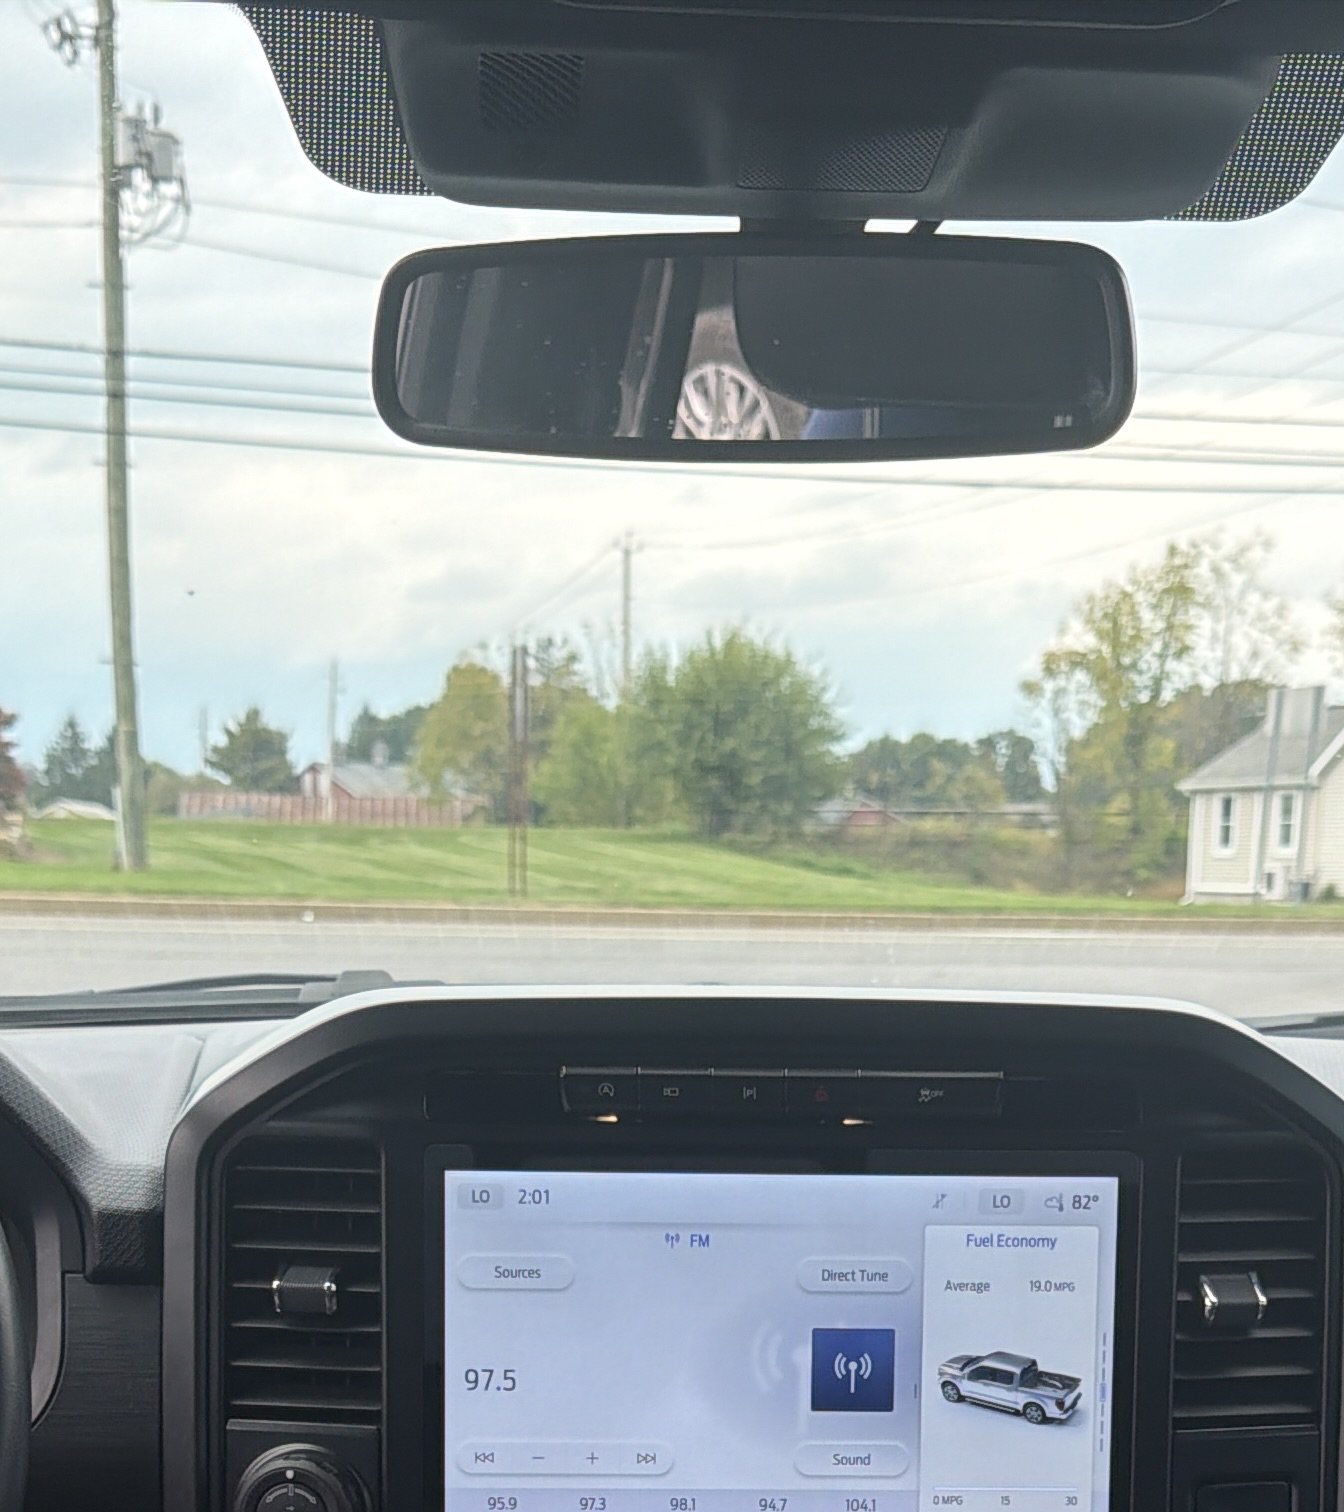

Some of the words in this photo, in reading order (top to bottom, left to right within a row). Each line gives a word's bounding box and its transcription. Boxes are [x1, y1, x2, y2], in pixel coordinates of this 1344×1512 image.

[471, 1189, 490, 1204] LO
[517, 1189, 550, 1205] 2:01
[992, 1195, 1011, 1209] LO
[690, 1233, 710, 1248] FM
[966, 1233, 994, 1248] Fuel
[997, 1234, 1057, 1250] Economy
[494, 1264, 541, 1280] Sources
[821, 1268, 856, 1283] Direct
[859, 1268, 889, 1283] Tune
[944, 1279, 991, 1294] Average
[1029, 1280, 1052, 1293] 19.0
[1053, 1282, 1076, 1293] MPG
[464, 1368, 517, 1393] 97.5
[832, 1452, 871, 1467] Sound
[487, 1497, 518, 1511] 95.9
[579, 1497, 606, 1511] 97.3
[669, 1497, 697, 1512] 98.1
[758, 1498, 788, 1512] 94.7
[845, 1498, 877, 1512] 104.1
[932, 1495, 940, 1505] 0
[942, 1495, 963, 1506] MPG
[1000, 1496, 1010, 1506] 15
[1064, 1496, 1078, 1506] 30
